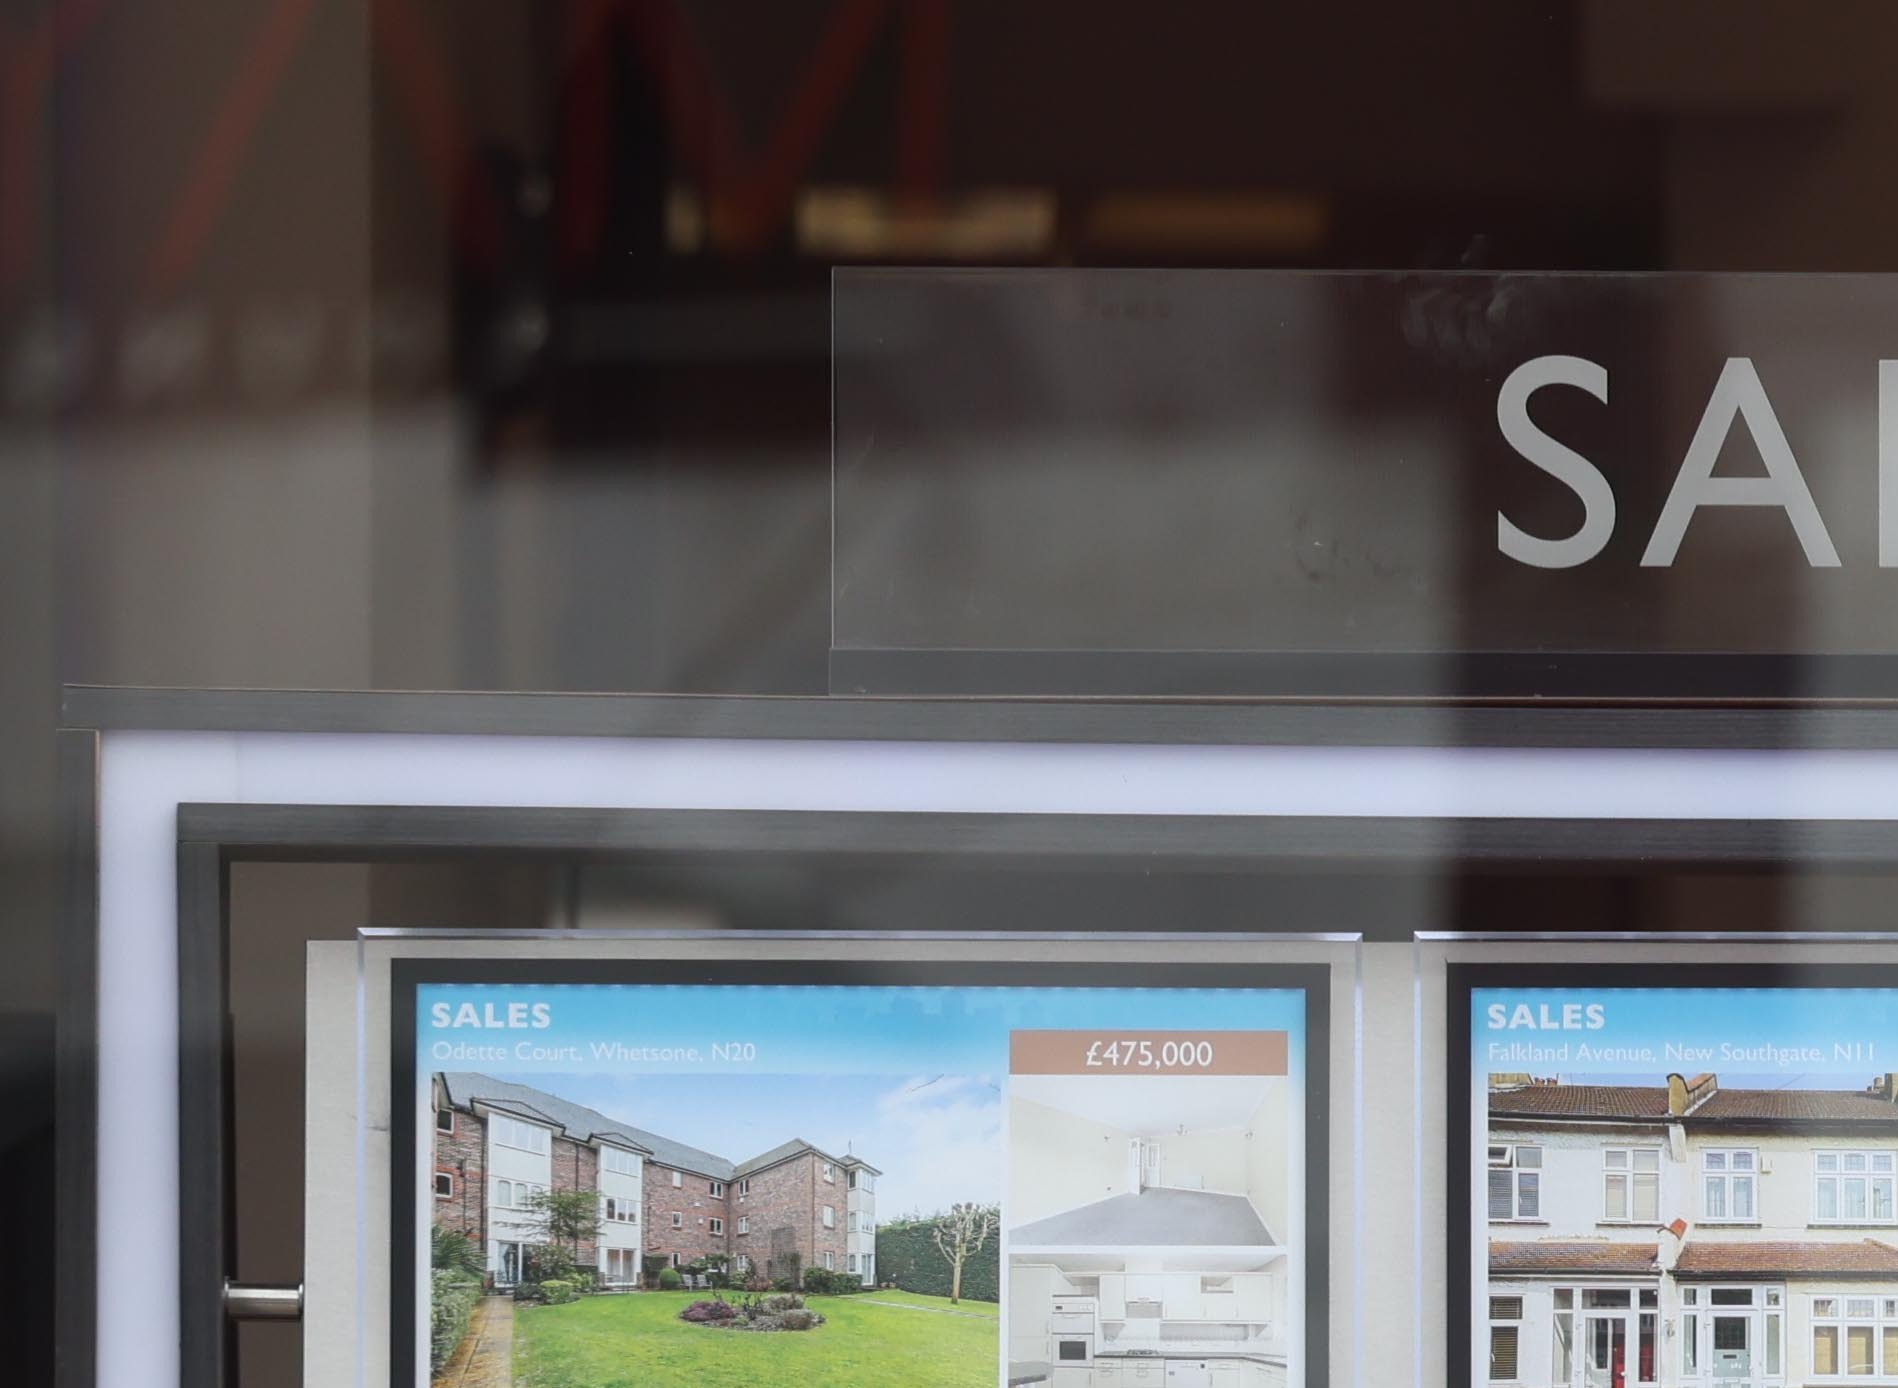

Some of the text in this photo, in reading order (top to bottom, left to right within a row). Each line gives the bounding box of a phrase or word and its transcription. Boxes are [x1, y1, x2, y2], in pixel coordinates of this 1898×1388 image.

[432, 1002, 550, 1028] SALES
[1488, 1004, 1604, 1029] SALES
[432, 1041, 507, 1062] Odette
[712, 1042, 756, 1060] N20
[1086, 1041, 1213, 1070] £475,000
[1488, 1042, 1568, 1062] Falkland
[1665, 1042, 1712, 1061] New
[1834, 1042, 1873, 1061] N11
